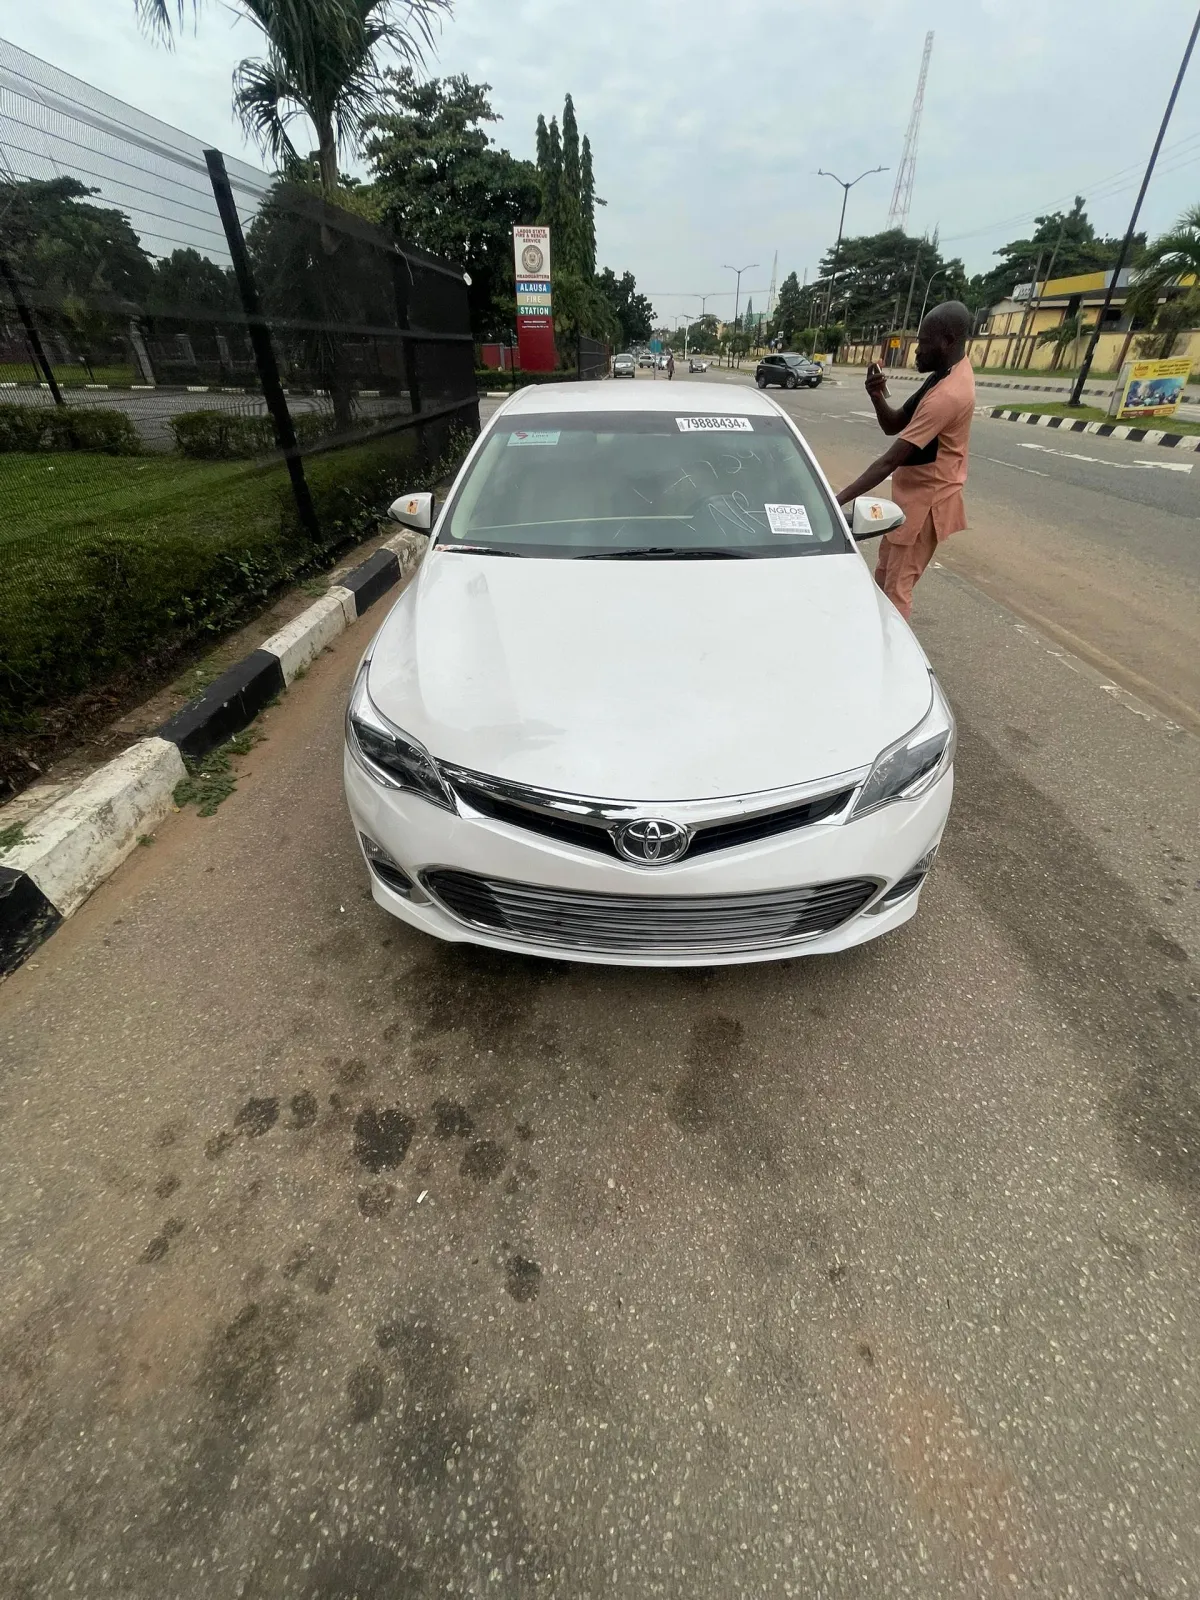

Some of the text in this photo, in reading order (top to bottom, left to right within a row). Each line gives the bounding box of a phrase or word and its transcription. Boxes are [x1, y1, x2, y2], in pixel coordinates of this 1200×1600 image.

[520, 283, 547, 292] ALAUSA
[526, 295, 542, 303] FIRE
[520, 306, 549, 315] STATION
[768, 507, 805, 515] NGLOS
